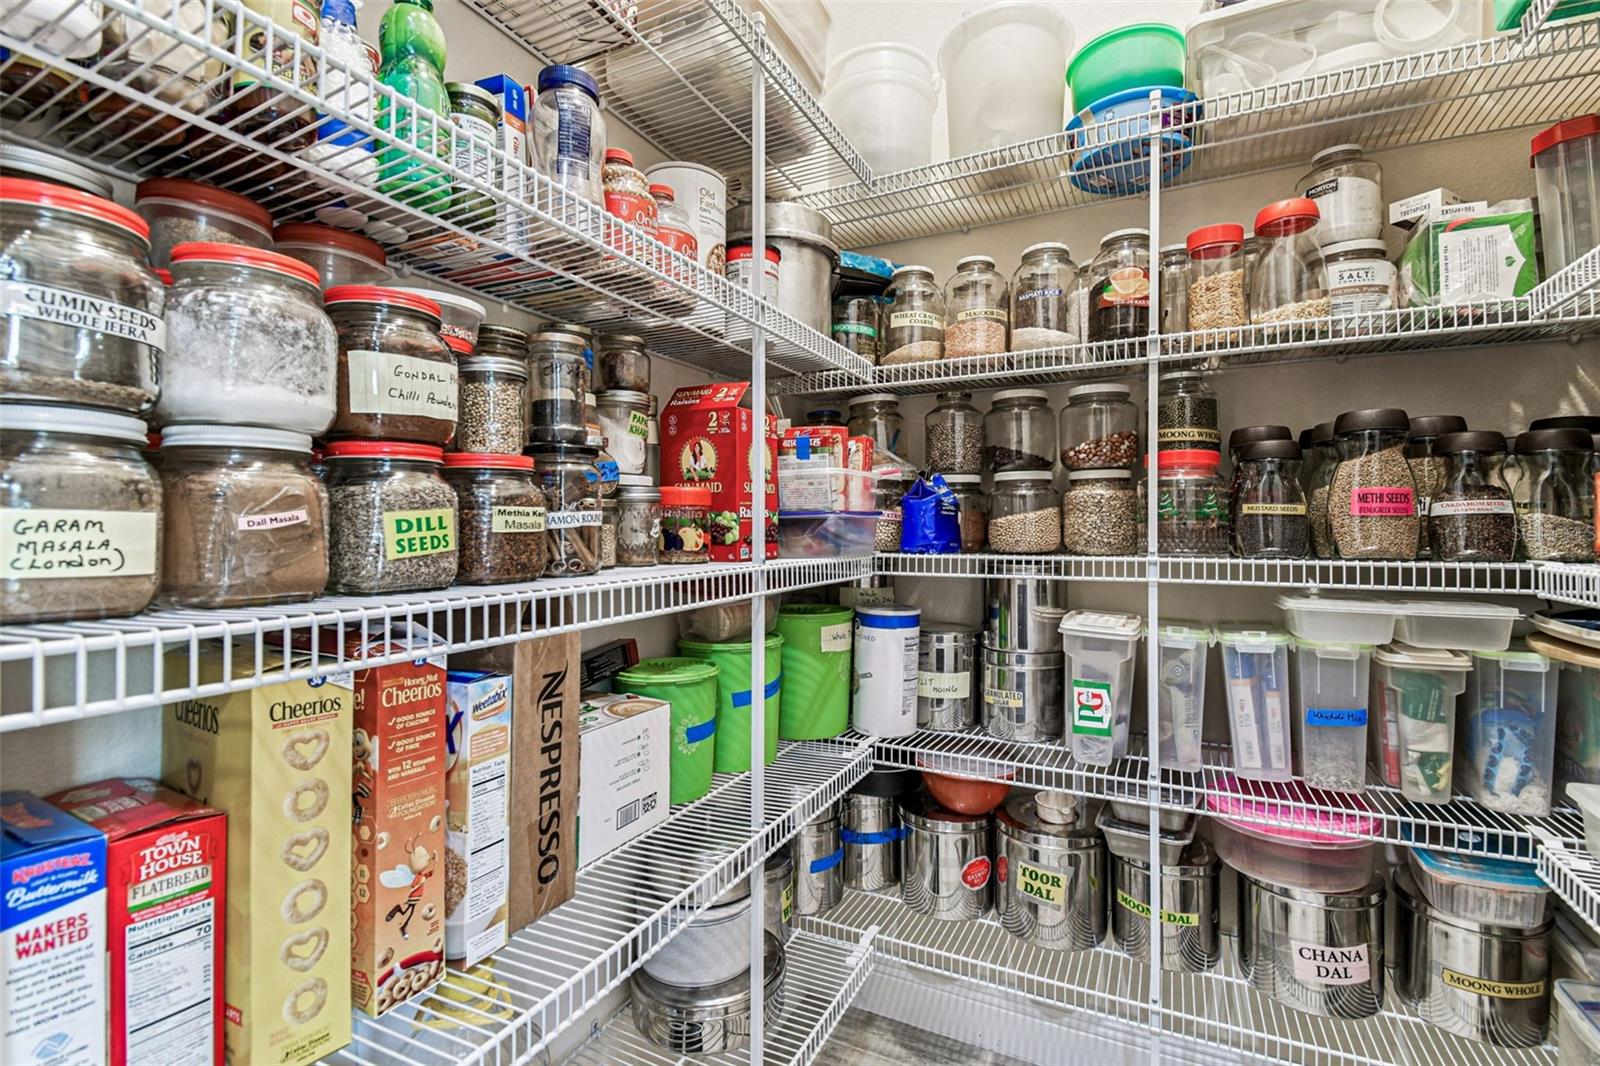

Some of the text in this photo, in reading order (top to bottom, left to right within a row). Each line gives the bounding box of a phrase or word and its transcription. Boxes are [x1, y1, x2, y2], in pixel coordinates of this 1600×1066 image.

[700, 187, 716, 201] Old
[1308, 181, 1338, 196] MORTON
[1400, 202, 1431, 217] TOOTHPICKS
[1338, 271, 1370, 281] SALT
[24, 287, 158, 333] CUMIN SEEDS
[893, 312, 918, 320] WHEAT
[36, 305, 149, 342] WHOLE JEERA
[393, 365, 447, 383] GONDAL
[670, 398, 701, 407] Raisins
[708, 411, 719, 428] 2
[1159, 430, 1195, 439] MOONG
[1357, 492, 1410, 504] METHI SEEDS
[496, 508, 531, 518] Methia
[1247, 505, 1299, 513] MUSTARD SEEDS
[13, 518, 105, 534] GARAM
[246, 514, 301, 528] Dall Masala
[394, 515, 449, 535] DILL
[504, 520, 542, 531] Masala
[16, 539, 110, 555] MASALA
[394, 533, 451, 555] SEEDS
[10, 547, 126, 573] (London)
[404, 673, 439, 688] Honey Nut
[382, 682, 443, 708] Cheerios
[472, 687, 508, 714] Weetabix
[985, 689, 1022, 701] GRANULATED
[269, 696, 341, 722] Cheerios
[402, 759, 413, 771] 12
[536, 659, 569, 885] NESPRESSO
[140, 836, 201, 866] TOWN
[139, 850, 203, 882] HOUSE
[132, 867, 210, 901] FLATBREAD
[1020, 864, 1062, 889] TOOR
[5, 869, 99, 908] Buttermilk
[359, 888, 366, 898] 12
[1023, 881, 1055, 902] DAL
[127, 912, 180, 934] Nutrition
[182, 901, 212, 916] Facts
[1167, 913, 1193, 925] DAL
[16, 912, 88, 946] MAKERS
[196, 924, 212, 937] 70
[16, 926, 89, 961] WANTED
[128, 941, 175, 961] Calories
[1298, 946, 1364, 964] CHANA
[1315, 965, 1353, 980] DAL
[1448, 974, 1542, 996] MOONG WHOLE
